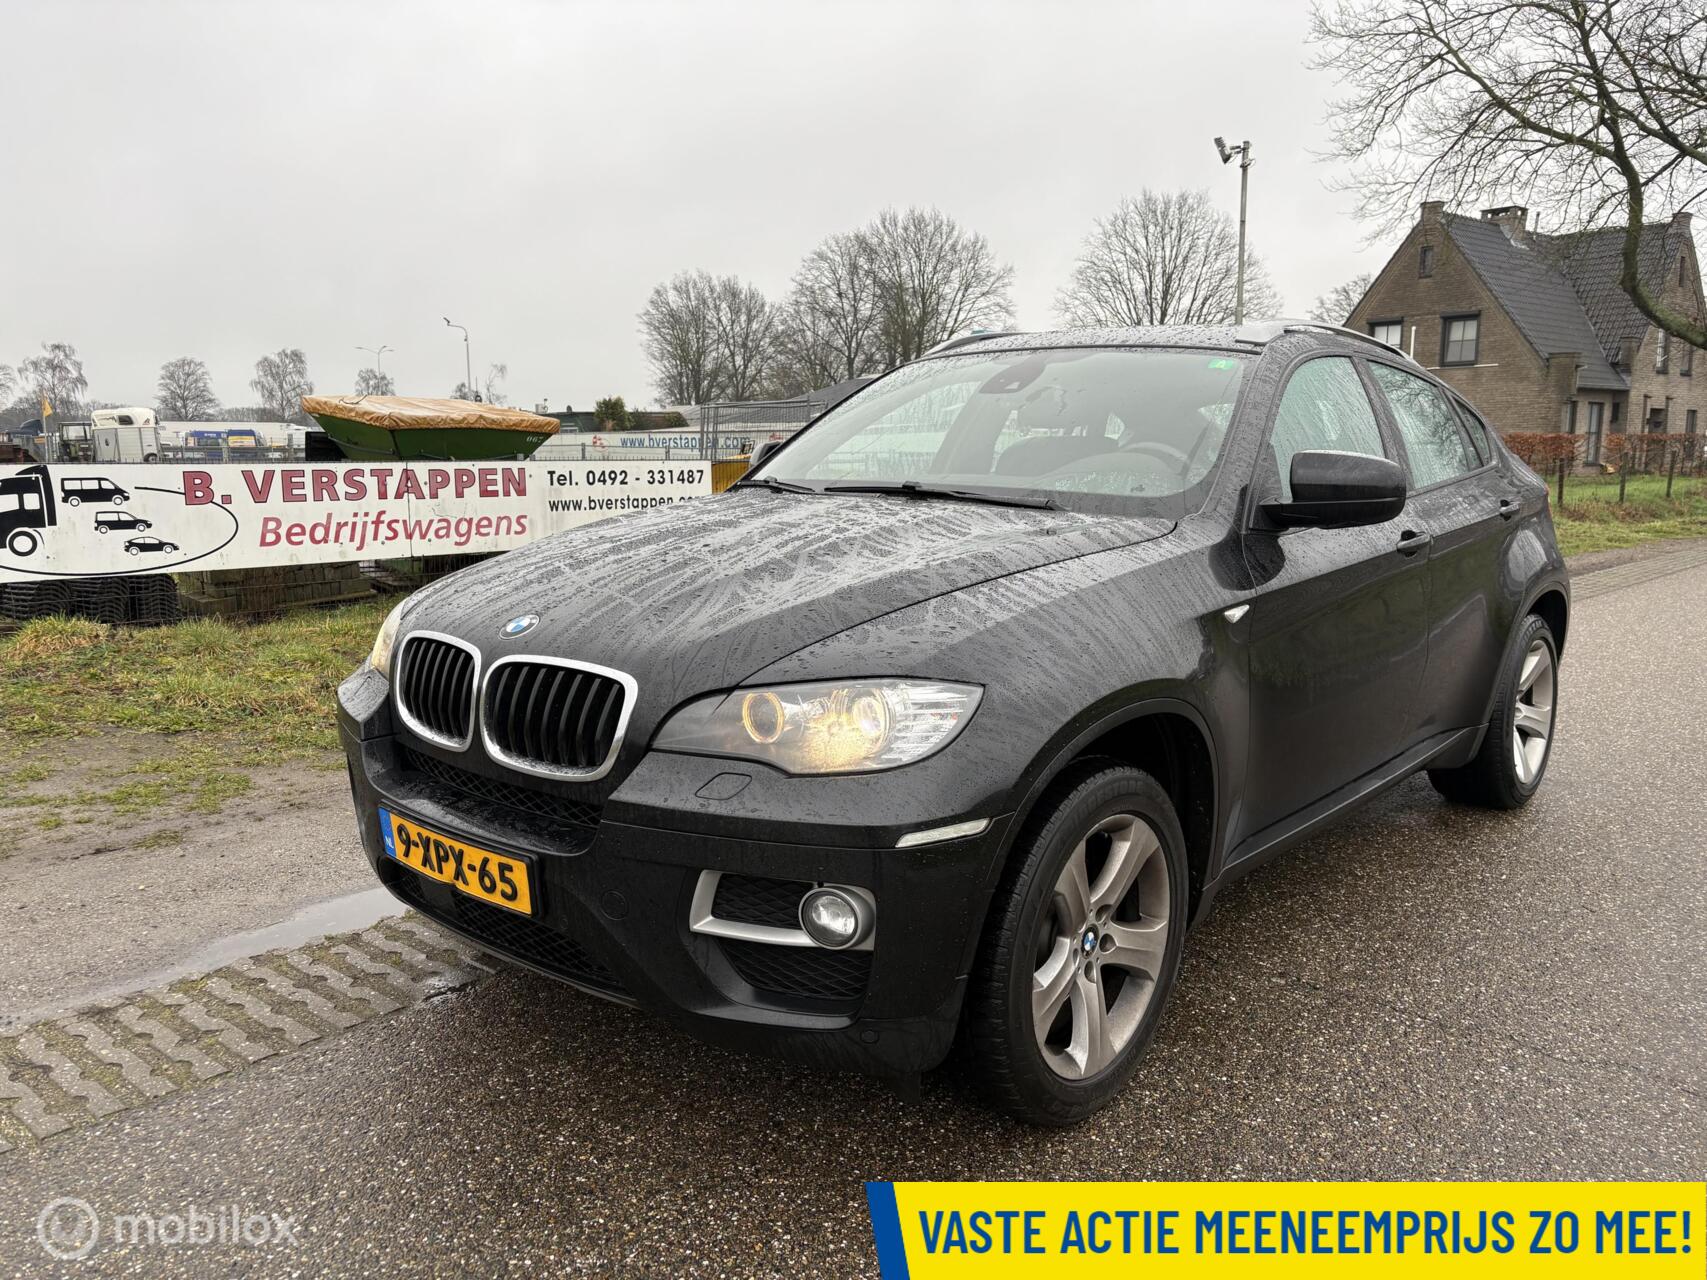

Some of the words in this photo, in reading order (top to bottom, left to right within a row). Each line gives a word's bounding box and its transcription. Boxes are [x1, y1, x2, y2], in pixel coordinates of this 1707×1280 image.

[182, 470, 232, 506] B.
[241, 467, 527, 504] VERSTAPPEN
[547, 470, 579, 487] Tel.
[586, 470, 629, 486] 0492
[646, 469, 704, 486] 331487
[259, 509, 528, 552] Bedrijfswagens
[385, 835, 395, 849] NL
[396, 822, 518, 902] 9-XPX-65
